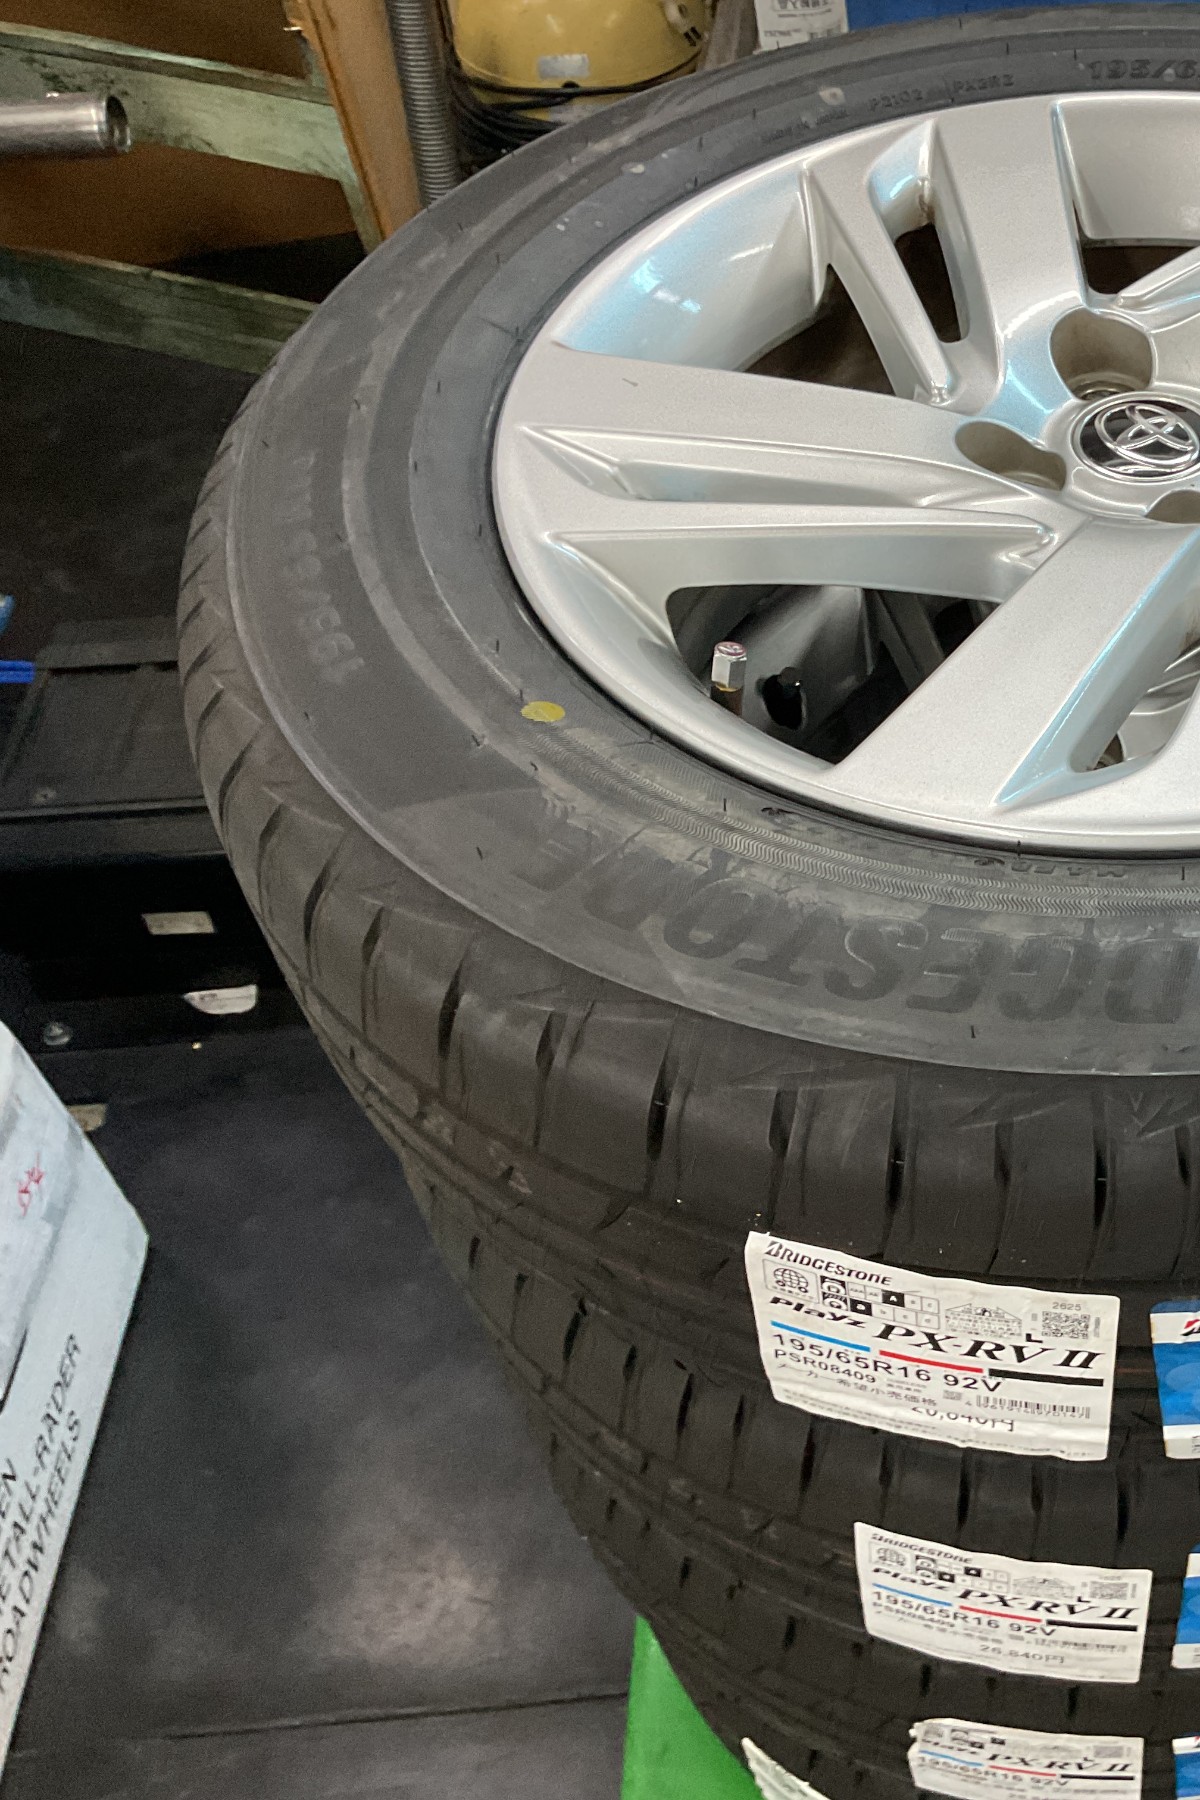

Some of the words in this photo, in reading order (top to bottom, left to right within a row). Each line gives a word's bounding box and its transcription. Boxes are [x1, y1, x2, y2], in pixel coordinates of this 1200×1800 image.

[764, 1239, 893, 1287] BRIDGESTONE
[769, 1296, 867, 1329] Playz
[772, 1333, 931, 1382] 195/65R16
[943, 1373, 1002, 1392] 92V
[774, 1348, 877, 1384] PSR08409
[871, 1532, 974, 1564] BRIDGESTONE
[871, 1591, 1000, 1629] 195/65R16
[1009, 1622, 1056, 1636] 92V
